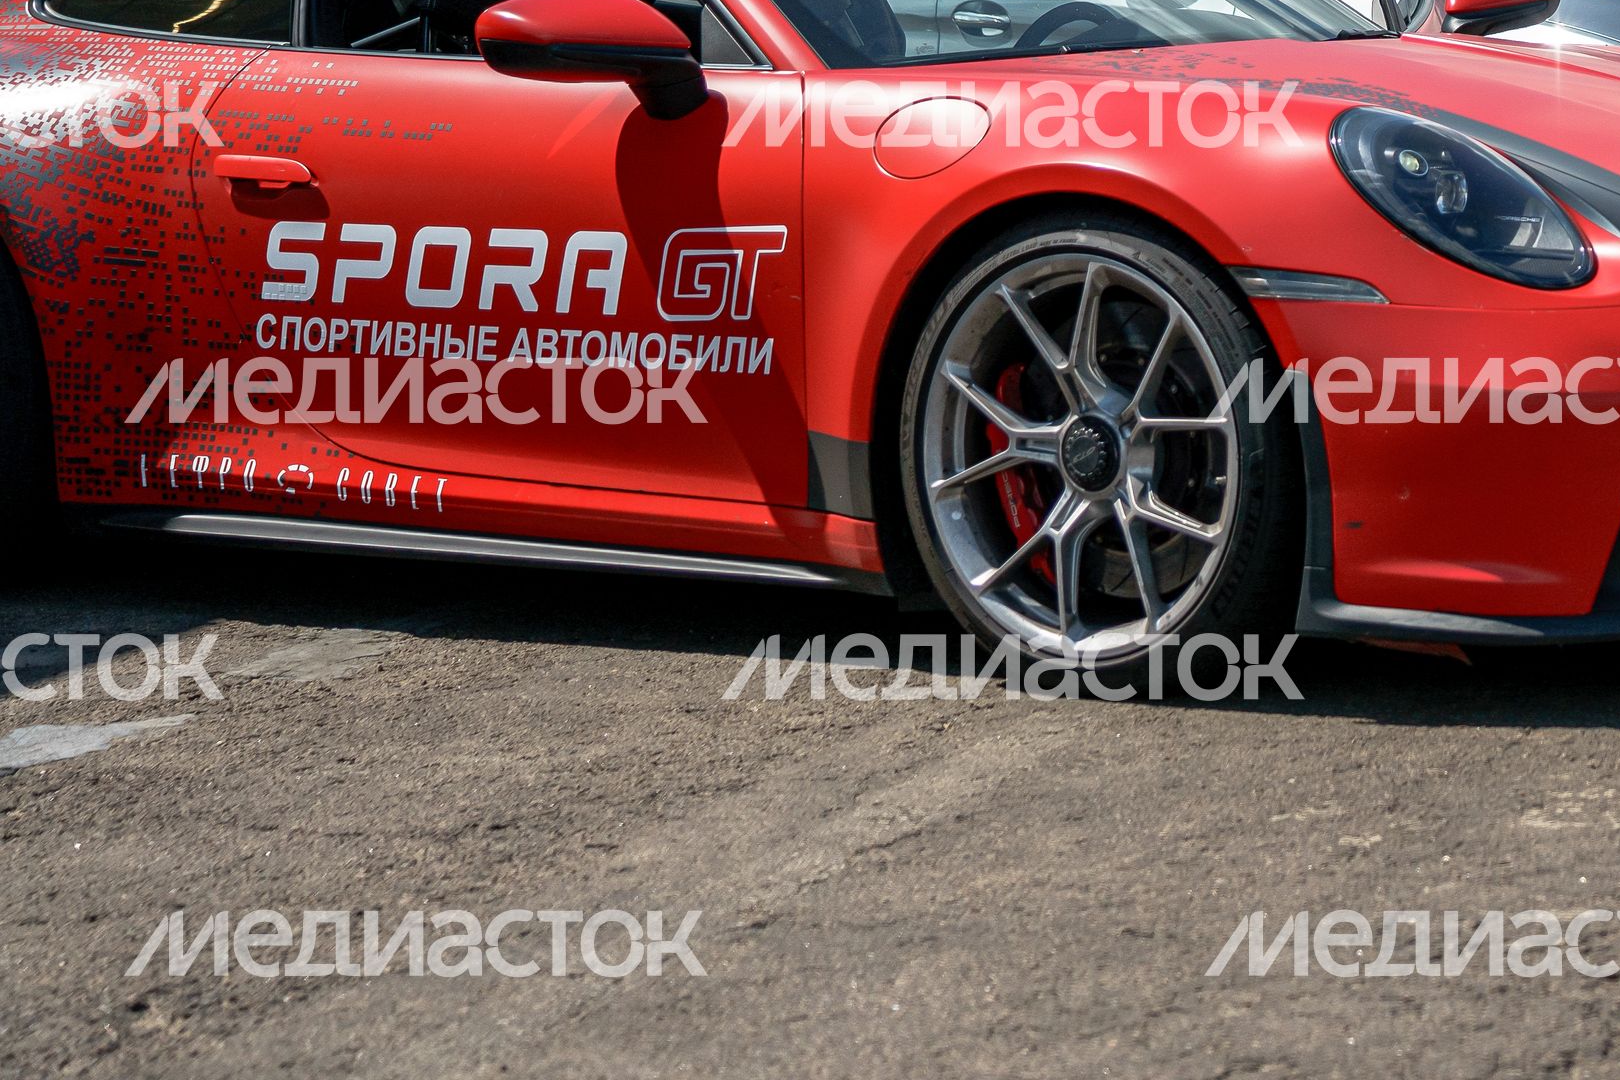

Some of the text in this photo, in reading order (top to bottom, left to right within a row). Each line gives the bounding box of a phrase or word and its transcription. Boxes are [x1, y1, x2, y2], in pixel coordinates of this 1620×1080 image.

[261, 221, 788, 321] SPORA GT
[256, 313, 774, 375] СПОРТИВНЫЕ АВТОМОБИЛИ
[336, 468, 447, 513] СОВЕТ
